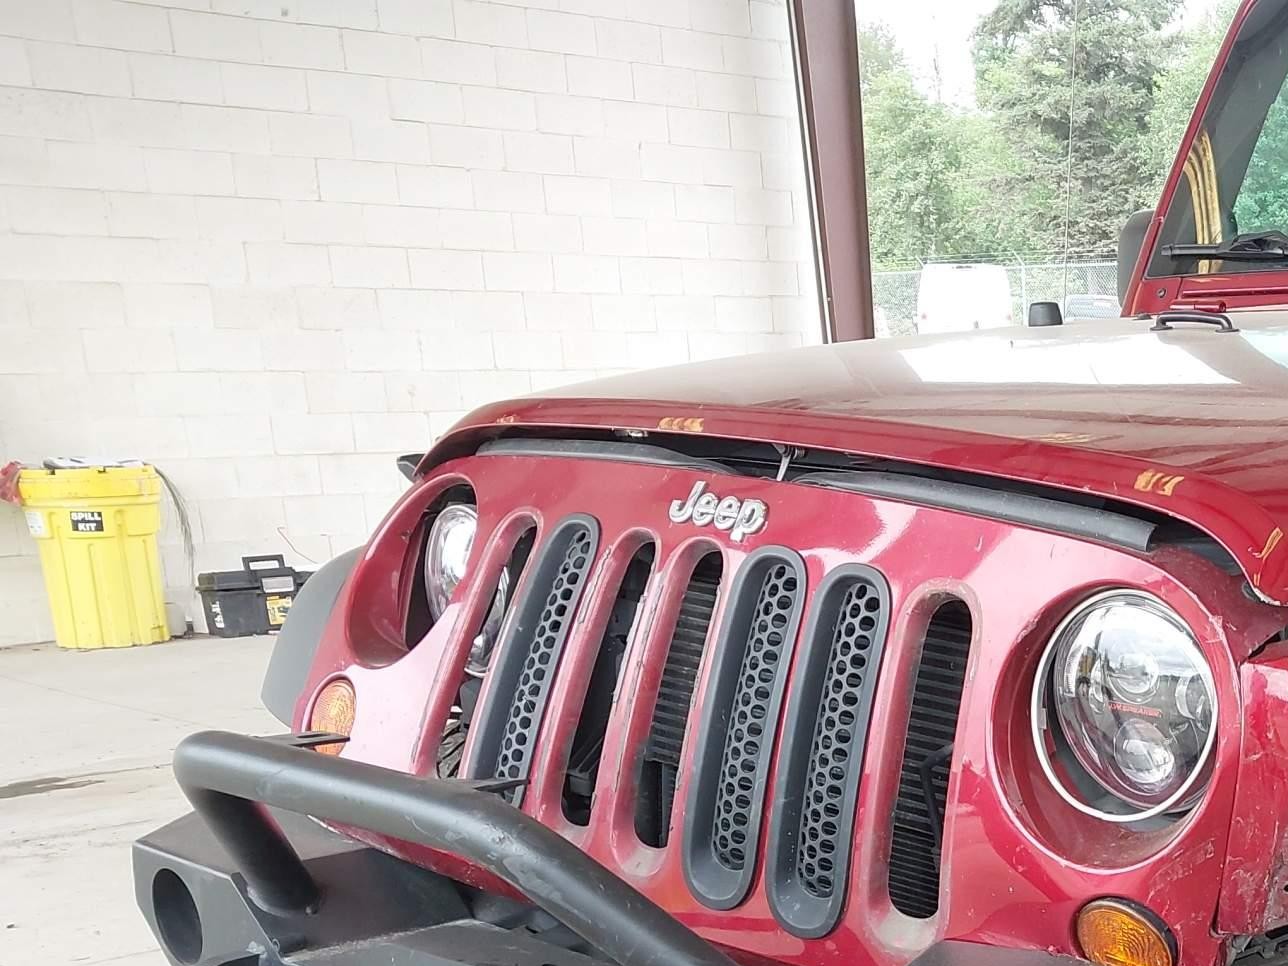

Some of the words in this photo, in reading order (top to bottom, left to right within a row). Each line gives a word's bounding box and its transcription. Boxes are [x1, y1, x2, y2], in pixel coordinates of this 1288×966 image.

[70, 511, 102, 520] SPILL
[669, 480, 768, 543] Jeep
[77, 522, 97, 531] KIT
